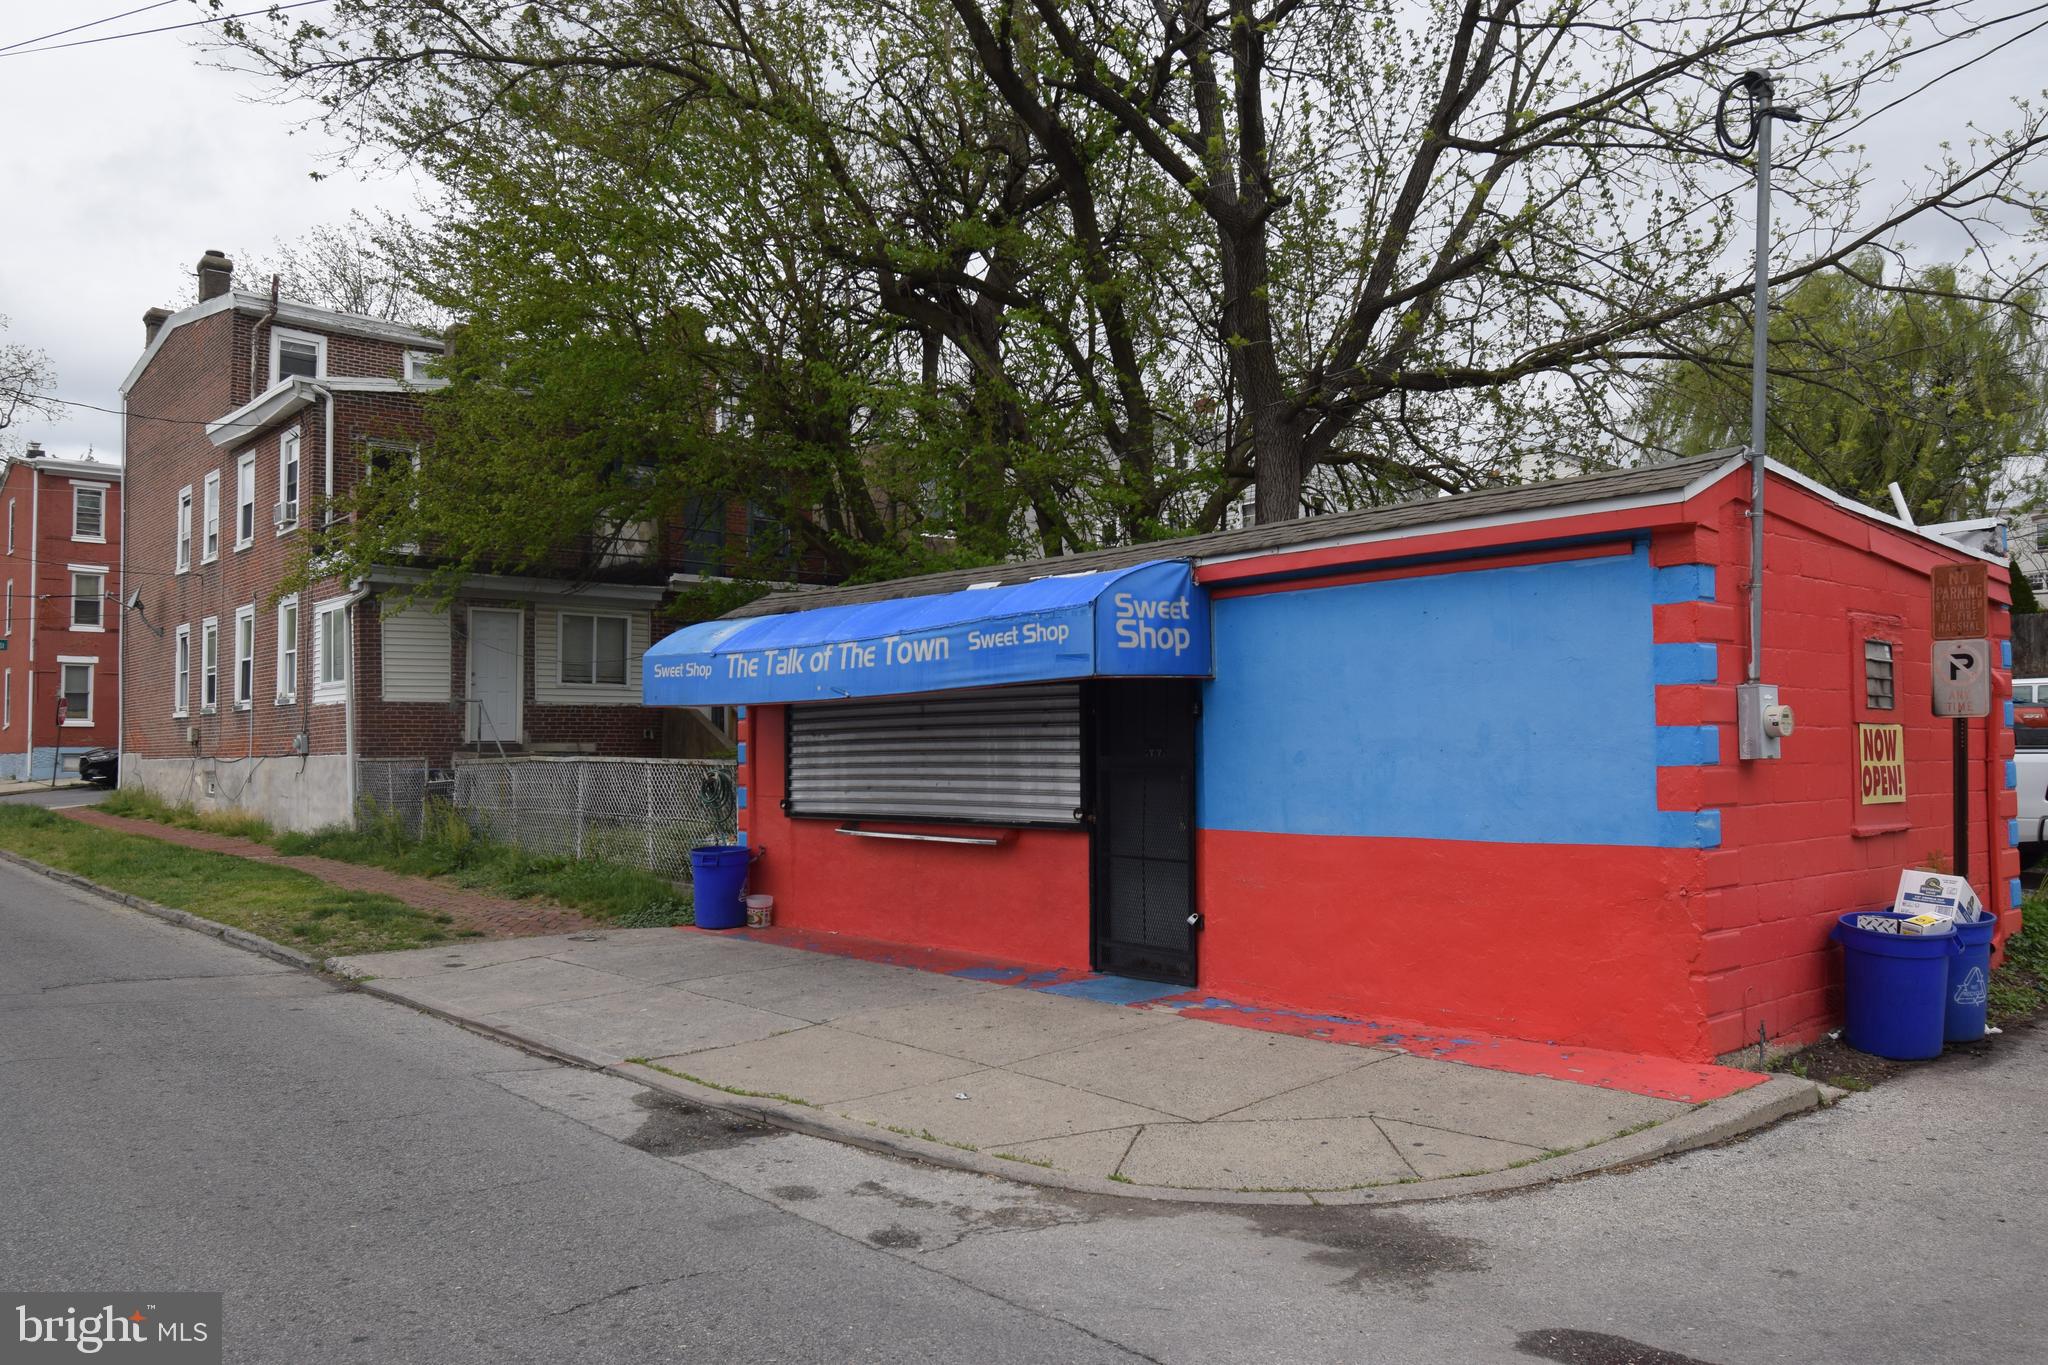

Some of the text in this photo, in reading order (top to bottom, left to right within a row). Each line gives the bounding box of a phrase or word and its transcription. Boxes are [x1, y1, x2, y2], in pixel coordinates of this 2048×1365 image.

[1949, 570, 1969, 585] NO
[1935, 584, 1982, 600] PARKING
[1115, 593, 1190, 620] Sweet
[967, 622, 1070, 650] Sweet Shop
[1115, 618, 1190, 657] Shop
[727, 635, 950, 679] The Talk of The Town
[654, 662, 713, 680] Sweet Shop
[1946, 702, 1974, 713] TIME
[1863, 728, 1897, 761] NOW
[1863, 764, 1903, 797] OPEN!
